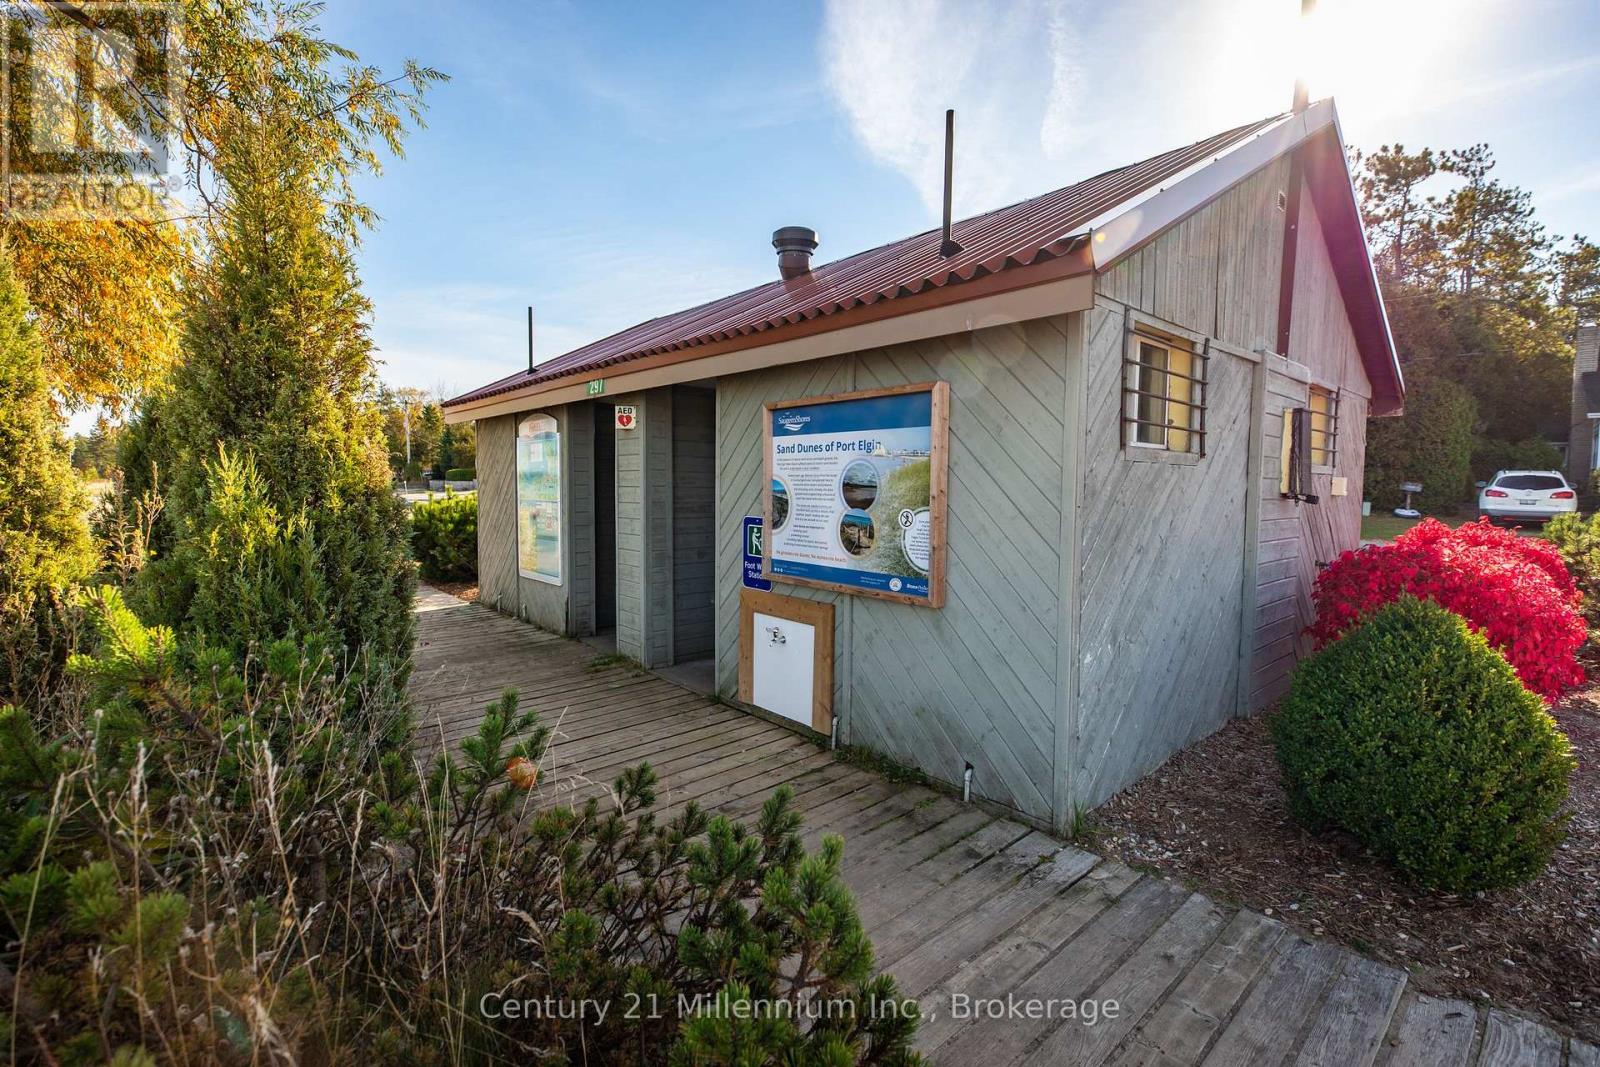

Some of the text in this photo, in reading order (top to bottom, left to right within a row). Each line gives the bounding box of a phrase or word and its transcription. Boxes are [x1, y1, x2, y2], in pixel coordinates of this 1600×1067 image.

[776, 439, 882, 454] Sand Dunes of Port Elgin
[744, 561, 755, 570] Foot
